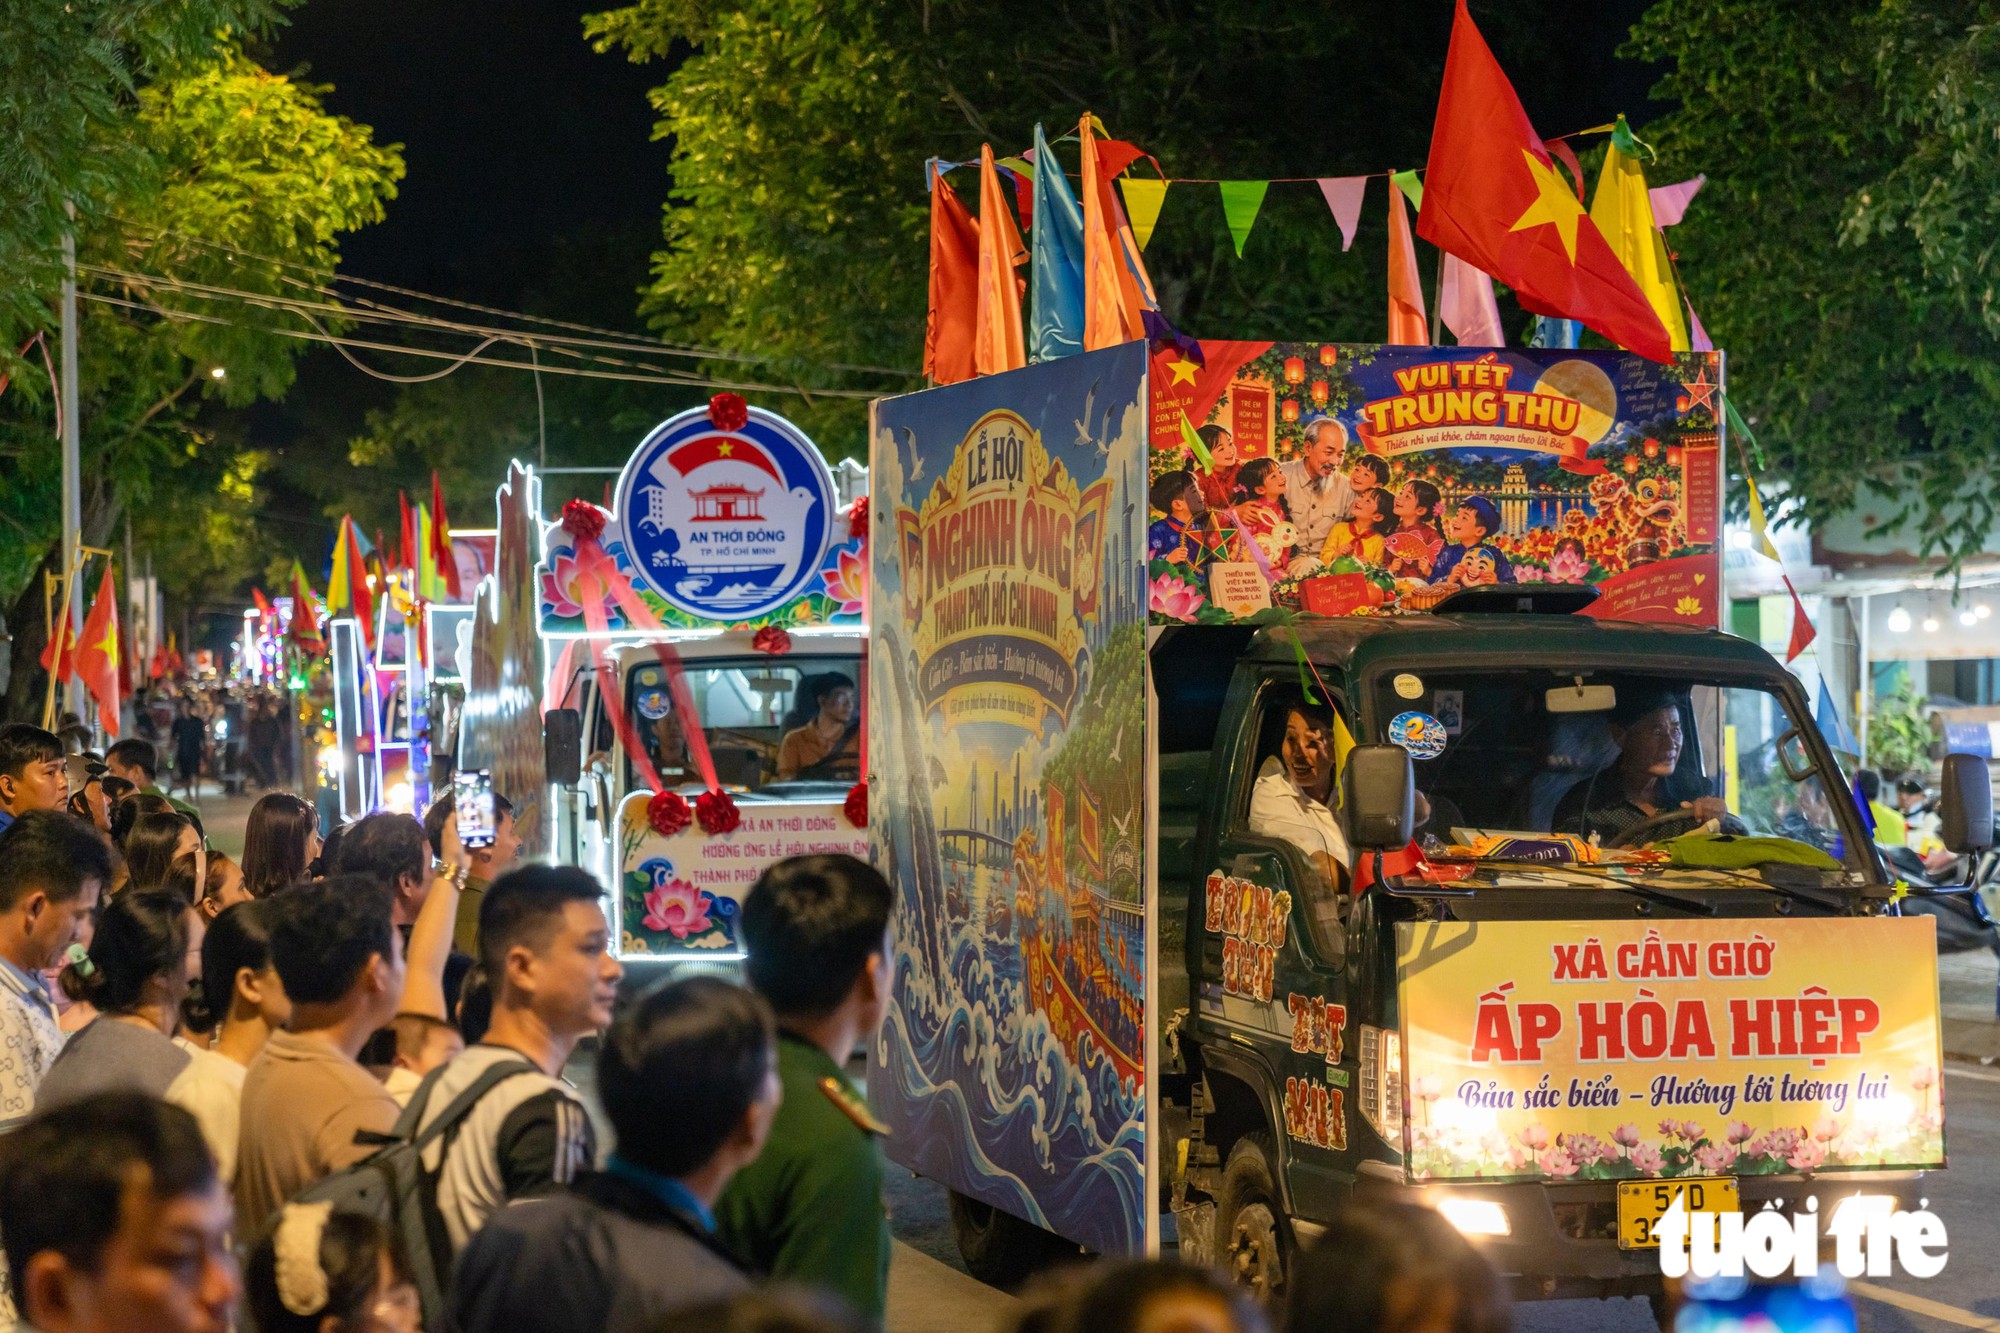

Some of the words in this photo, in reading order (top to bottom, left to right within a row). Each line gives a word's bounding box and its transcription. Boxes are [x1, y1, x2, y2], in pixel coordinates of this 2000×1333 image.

[1394, 363, 1451, 394] VUI
[1454, 353, 1511, 389] TẾT
[1155, 414, 1170, 423] CON
[1366, 390, 1499, 435] TRUNG
[1501, 392, 1580, 434] THU
[1385, 437, 1408, 451] Thiếu
[1411, 434, 1424, 445] nhi
[1427, 433, 1439, 443] vui
[1465, 430, 1487, 440] chăm
[1489, 432, 1515, 444] ngoan
[1517, 433, 1535, 444] theo
[1537, 436, 1548, 447] lời
[1550, 437, 1566, 450] Bác
[967, 428, 988, 492] LỄ
[991, 426, 1025, 492] HỘI
[690, 532, 709, 543] AN
[712, 528, 743, 543] THỚI
[746, 527, 785, 543] ĐÔNG
[926, 499, 1017, 602] NGHINH
[1021, 485, 1073, 591] ÔNG
[733, 547, 749, 556] CHÍ
[752, 547, 776, 555] MINH
[1224, 570, 1243, 578] THIẾU
[1226, 578, 1240, 586] VIỆT
[934, 586, 967, 643] THÀNH
[968, 569, 990, 629] PHỐ
[1009, 574, 1028, 629] CHÍ
[1029, 584, 1058, 641] MINH
[1406, 716, 1425, 740] 2
[759, 818, 774, 832] AN
[693, 869, 731, 884] THÀNH
[1552, 937, 1608, 980] XÃ
[1616, 929, 1698, 979] CẦN
[1707, 934, 1776, 977] GIỜ
[1471, 980, 1562, 1062] ẤP
[1577, 987, 1716, 1060] HÒA
[1729, 985, 1880, 1067] HIỆP
[1457, 1079, 1515, 1109] Bản
[1522, 1073, 1563, 1110] sắc
[1568, 1074, 1621, 1108] biển
[1650, 1075, 1739, 1116] Hướng
[1743, 1073, 1775, 1104] tới
[1780, 1073, 1849, 1113] tương
[1856, 1072, 1889, 1101] lai
